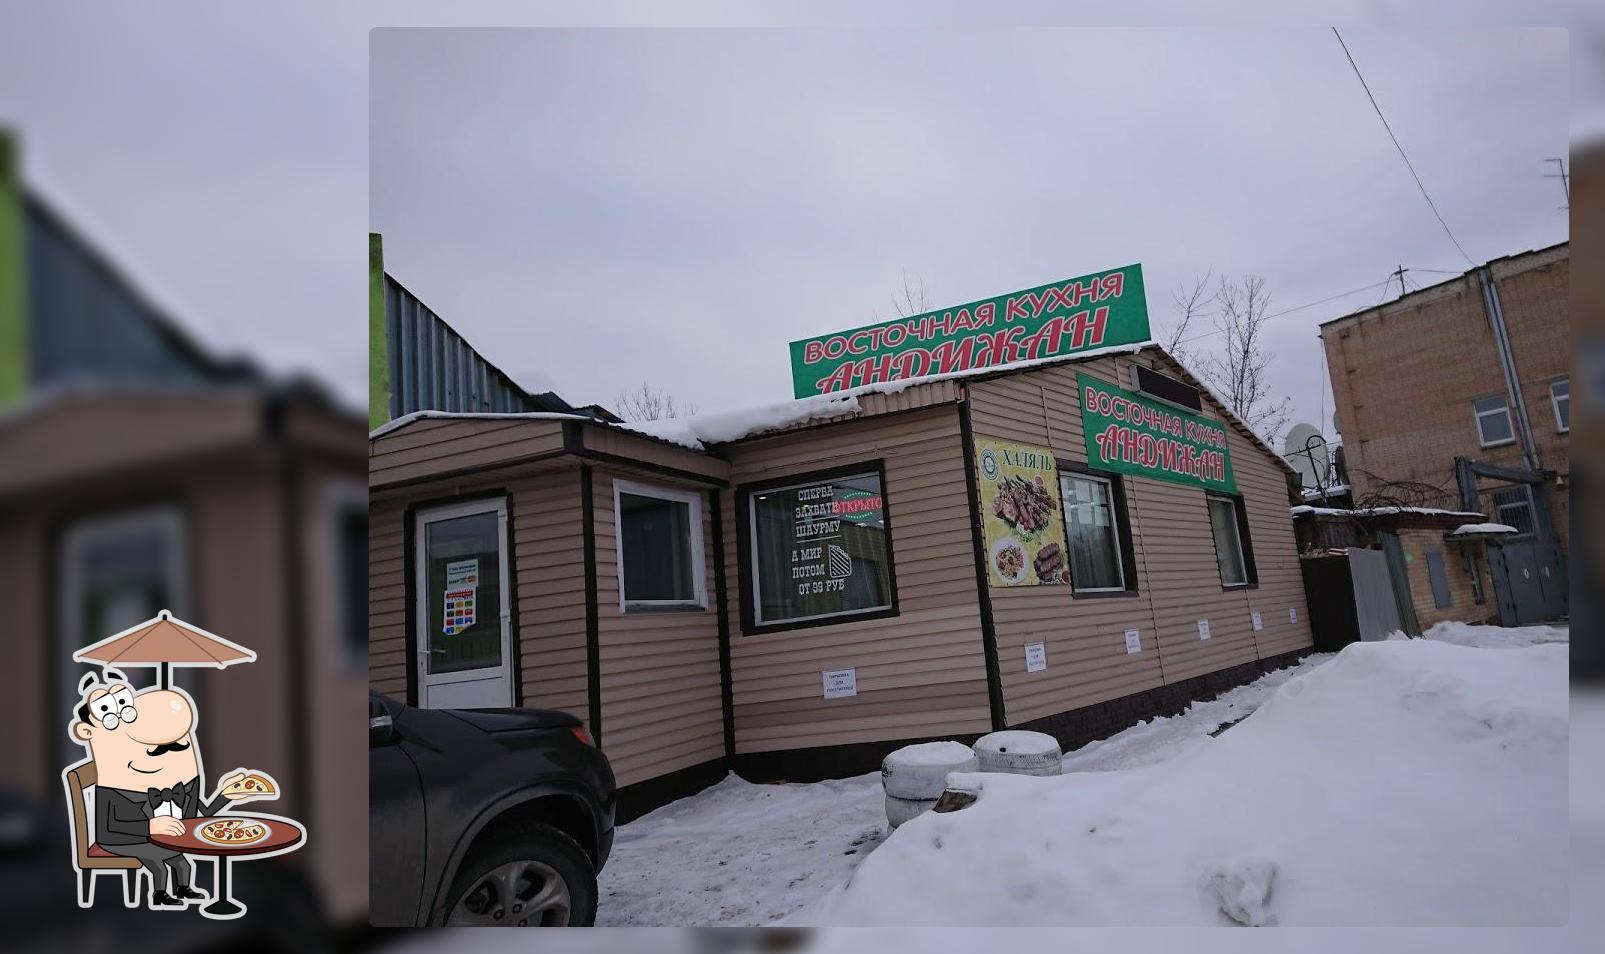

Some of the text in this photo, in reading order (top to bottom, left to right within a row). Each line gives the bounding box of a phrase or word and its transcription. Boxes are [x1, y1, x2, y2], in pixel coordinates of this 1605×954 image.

[804, 272, 1125, 364] ВОСТОЧНАЯ КУХНЯ
[816, 305, 1110, 394] АНДИЖАН
[1085, 386, 1227, 449] ВОСТОЧНАЯ КУХНЯ
[1002, 448, 1052, 470] ХАЛЯЛЬ
[1096, 423, 1225, 482] АНДИЖАН
[798, 485, 834, 501] СПЕРВА
[796, 520, 841, 537] ШАУРМУ
[791, 547, 822, 562] А МИР
[792, 564, 825, 578] ПОТОМ
[799, 579, 845, 595] ОТ 99 РУБ
